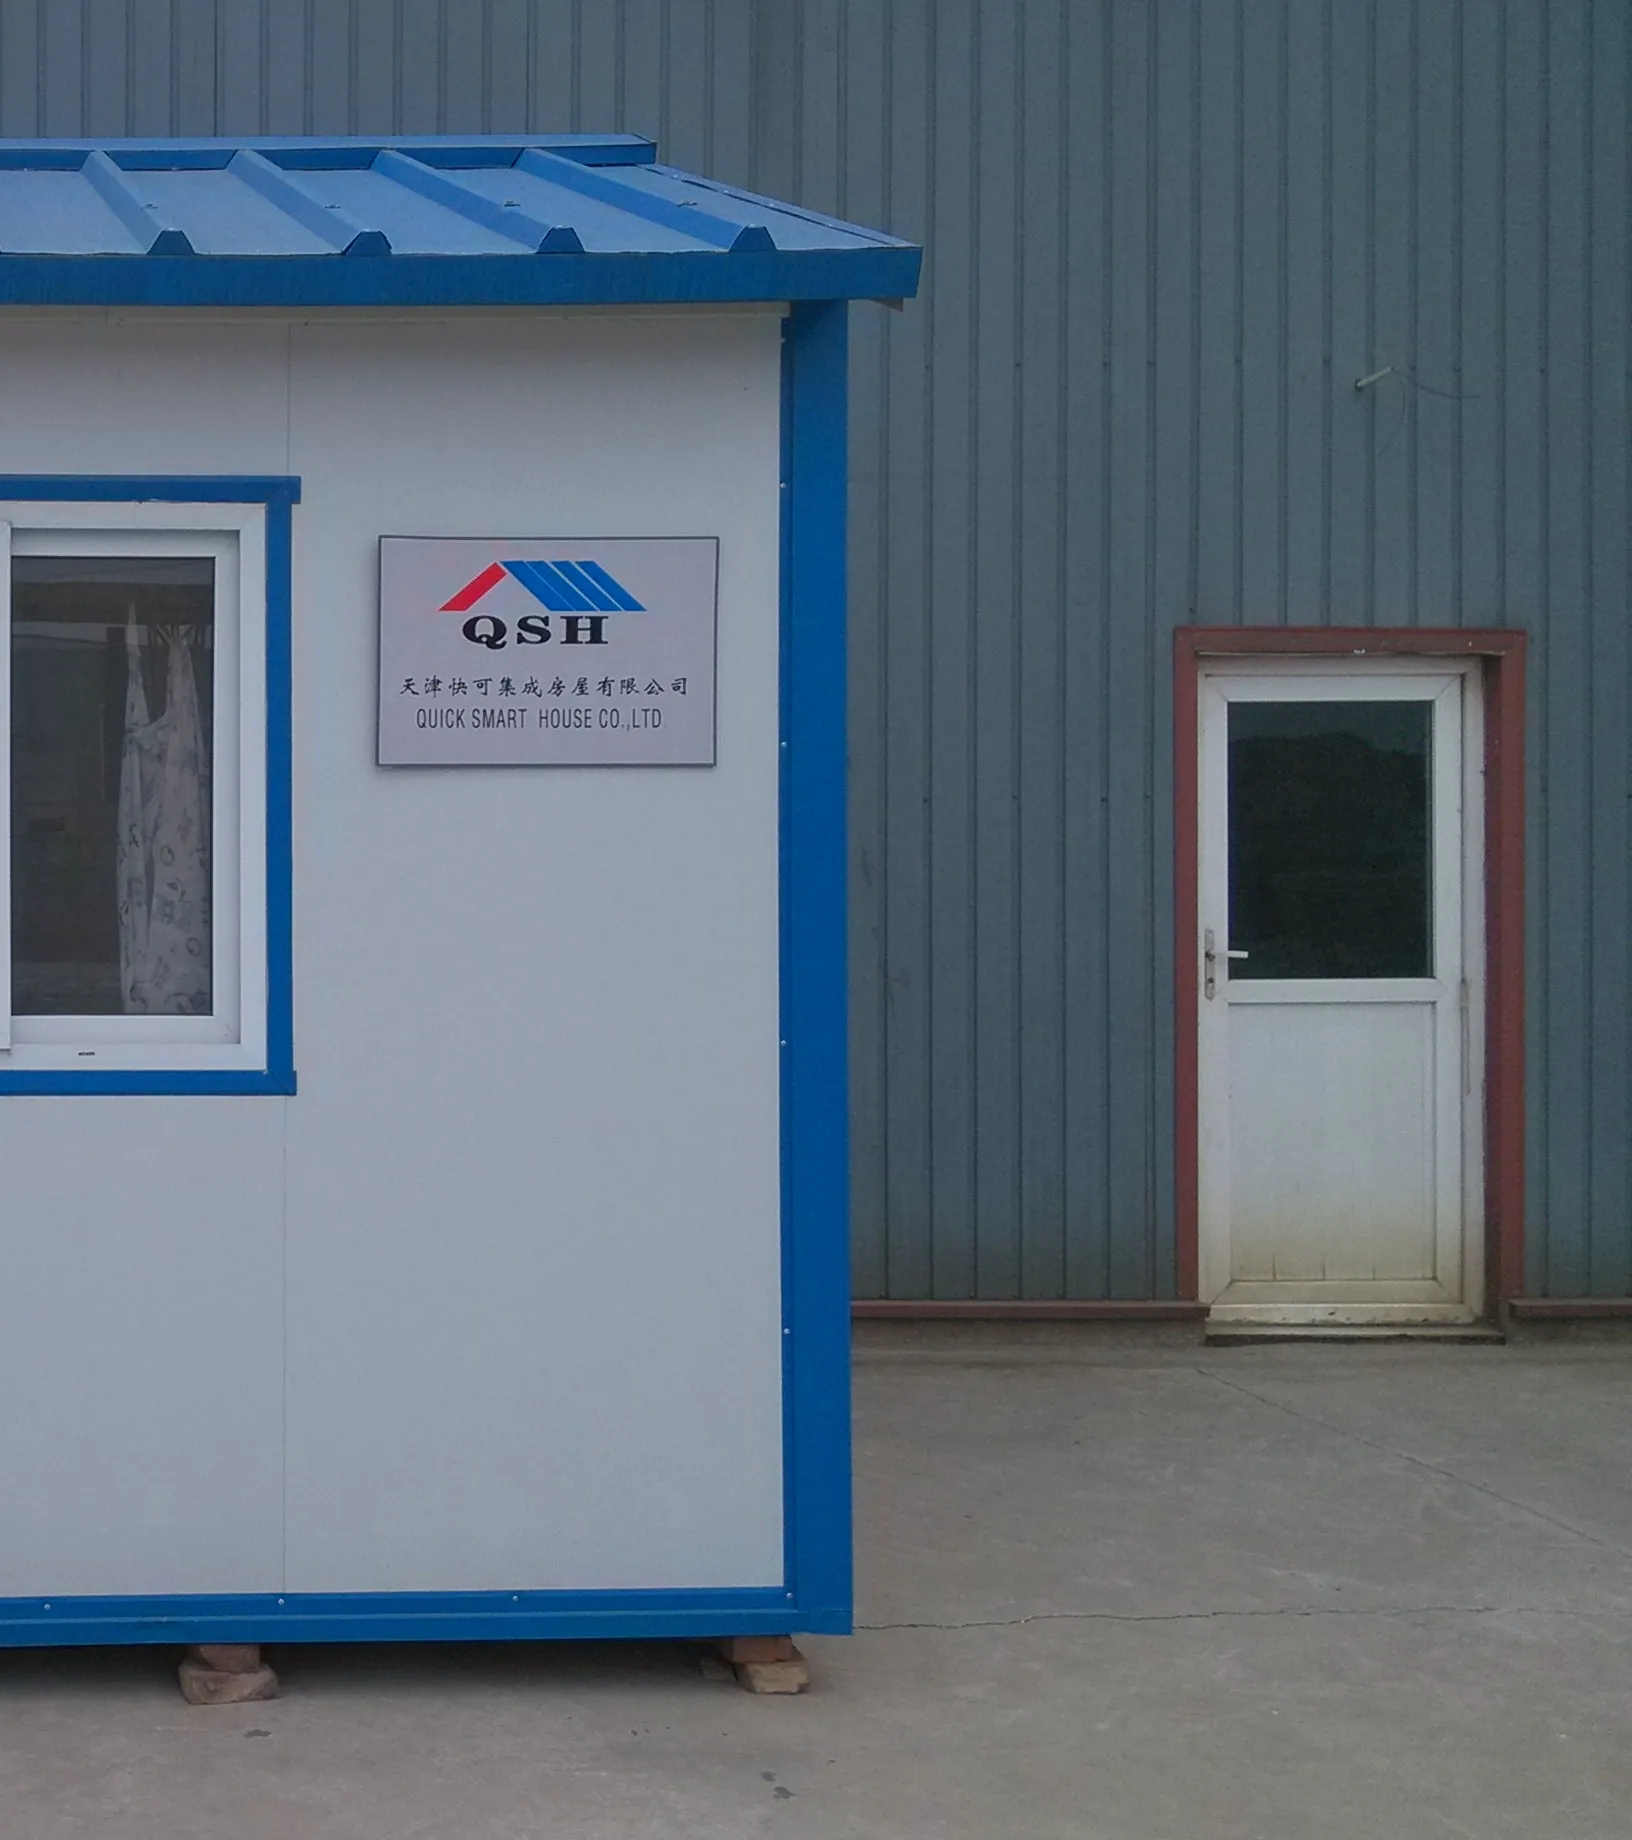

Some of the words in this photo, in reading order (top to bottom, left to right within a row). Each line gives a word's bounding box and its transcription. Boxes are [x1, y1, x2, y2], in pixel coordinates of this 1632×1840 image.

[462, 614, 609, 650] QSH
[399, 674, 688, 699] 天津快可集成房屋有限公司
[416, 708, 466, 729] QUICK
[471, 708, 528, 729] SMART
[538, 708, 593, 729] HOUSE
